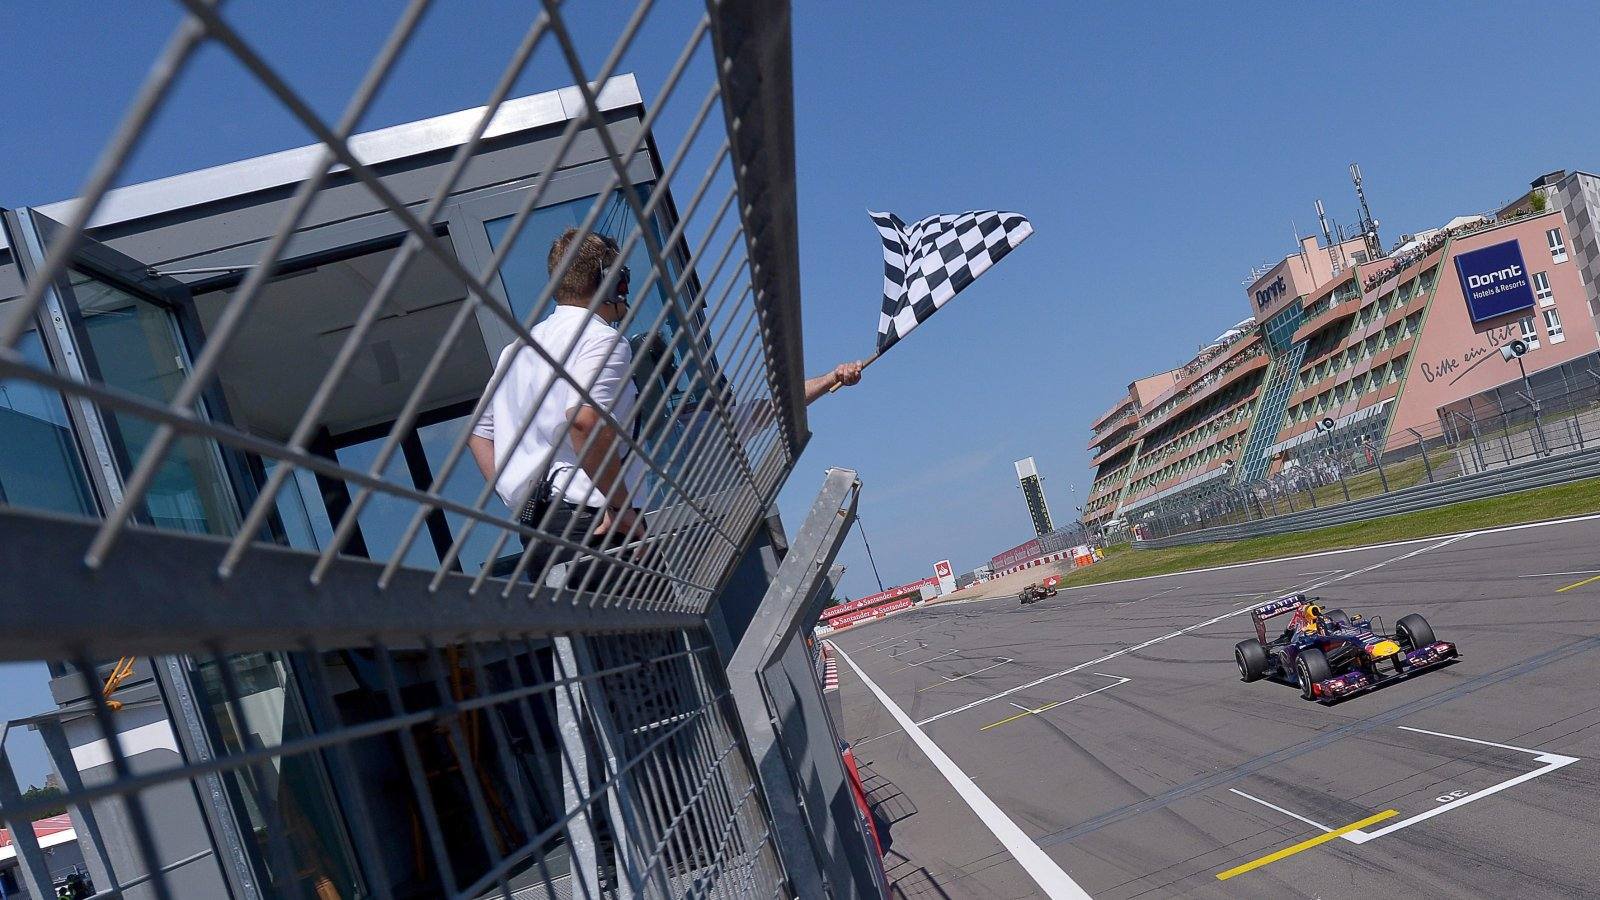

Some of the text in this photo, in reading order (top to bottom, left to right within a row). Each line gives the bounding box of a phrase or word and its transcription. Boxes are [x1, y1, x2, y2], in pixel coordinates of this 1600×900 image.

[1468, 264, 1522, 289] Dorint
[1256, 275, 1287, 308] Dorint
[1473, 280, 1526, 300] Hotels & Resorts
[1421, 322, 1516, 383] Bitte ein Bit
[863, 593, 892, 606] Santander
[878, 600, 909, 614] Santander
[823, 604, 853, 618] Santander
[839, 611, 870, 625] Santander
